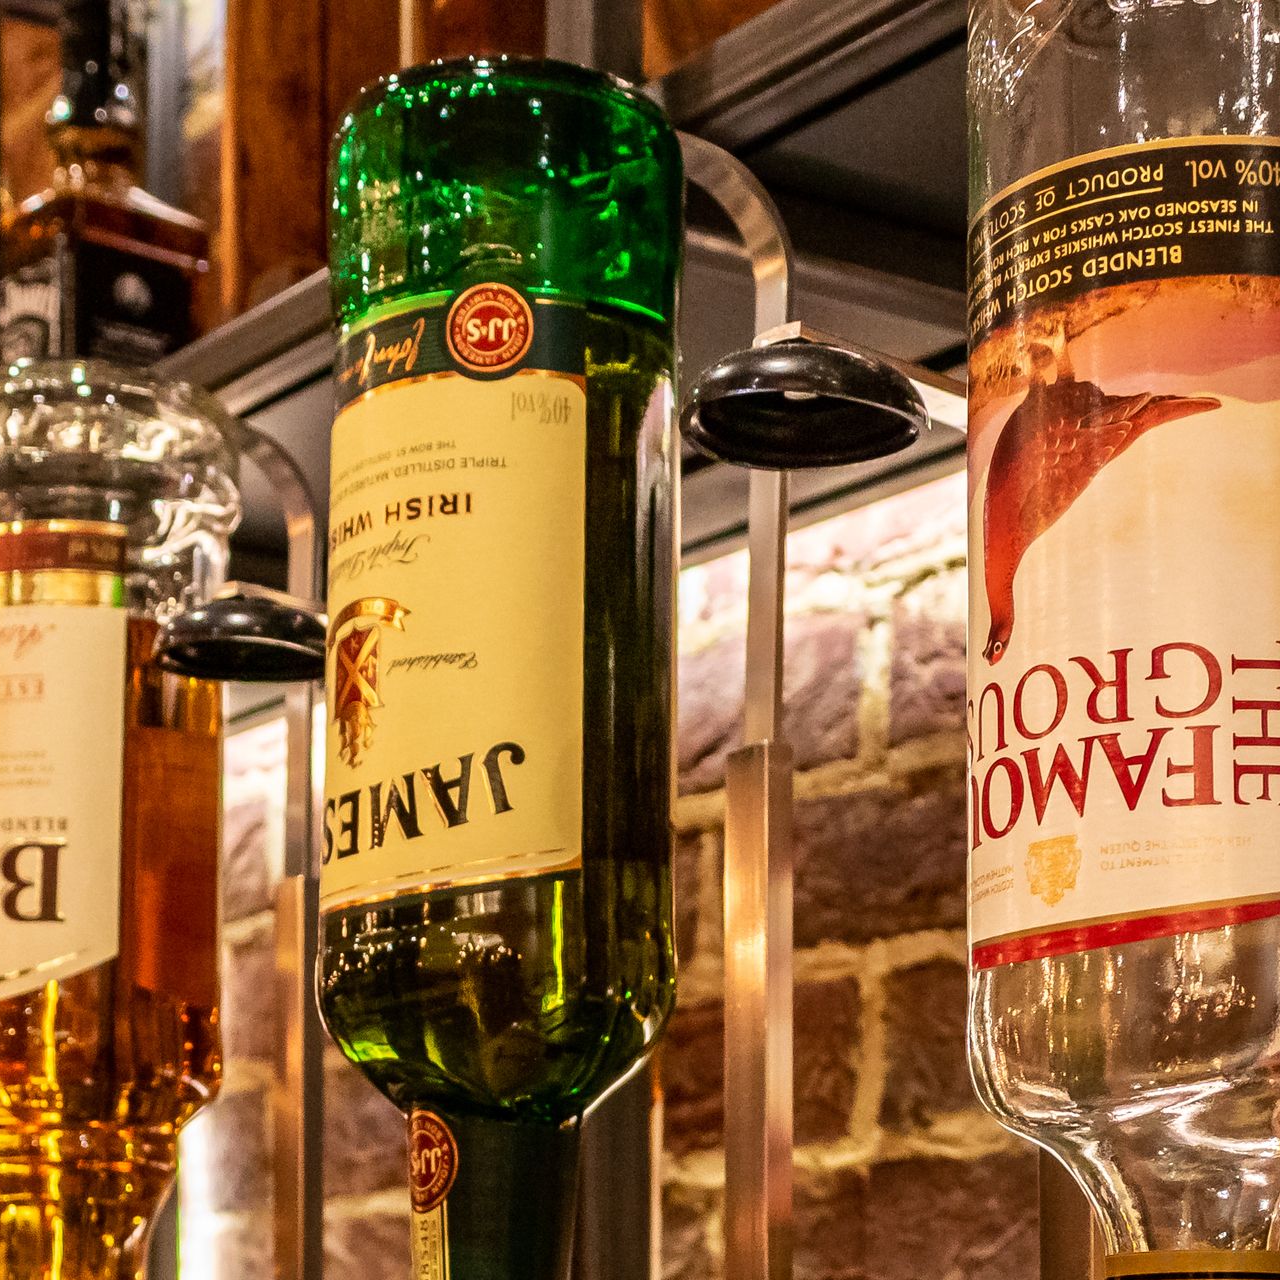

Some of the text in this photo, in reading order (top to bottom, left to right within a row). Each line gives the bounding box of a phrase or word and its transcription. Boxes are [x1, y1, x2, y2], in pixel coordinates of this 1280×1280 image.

[1065, 162, 1165, 200] PRODUCT
[1184, 159, 1228, 188] vol.
[1034, 188, 1056, 211] OF
[1155, 200, 1237, 218] SEASONED
[1242, 200, 1259, 214] IN
[1070, 211, 1115, 235] CASKS
[1118, 206, 1151, 224] OAK
[1043, 224, 1067, 244] FOR
[1122, 221, 1183, 243] SCOTCH
[1189, 219, 1241, 236] FINEST
[1246, 219, 1274, 234] THE
[1006, 239, 1029, 261] RICH
[1032, 234, 1040, 246] A
[1053, 231, 1118, 258] WHISKIES
[1004, 248, 1051, 283] EXPERTLY
[1082, 244, 1182, 278] BLENDED
[1006, 266, 1073, 308] SCOTCH
[437, 440, 457, 450] THE
[460, 456, 507, 469] TRIPLE
[384, 492, 473, 526] IRISH
[971, 724, 1223, 852] FAMO
[1099, 840, 1142, 855] QUEEN
